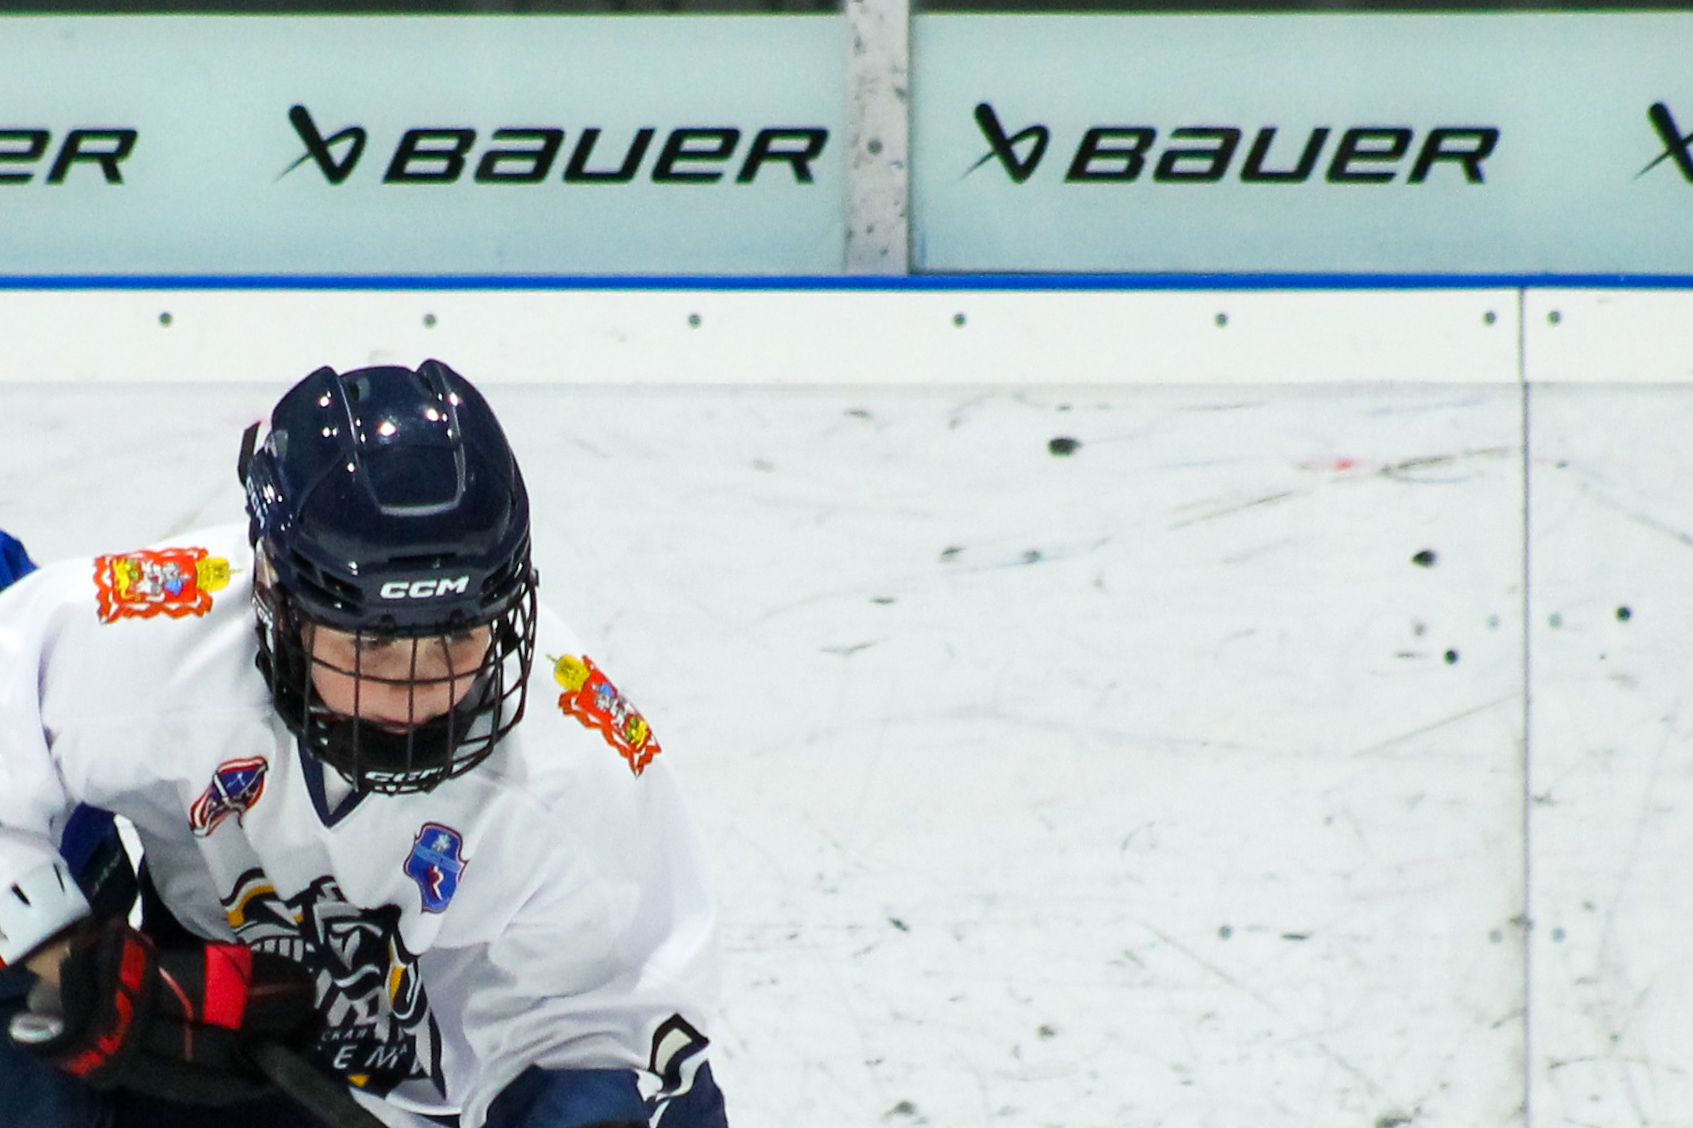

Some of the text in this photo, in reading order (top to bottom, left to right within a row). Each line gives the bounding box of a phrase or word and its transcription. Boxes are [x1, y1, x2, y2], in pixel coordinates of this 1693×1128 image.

[381, 127, 830, 184] BAUER
[1063, 126, 1501, 184] BAUER
[380, 575, 470, 599] CCM
